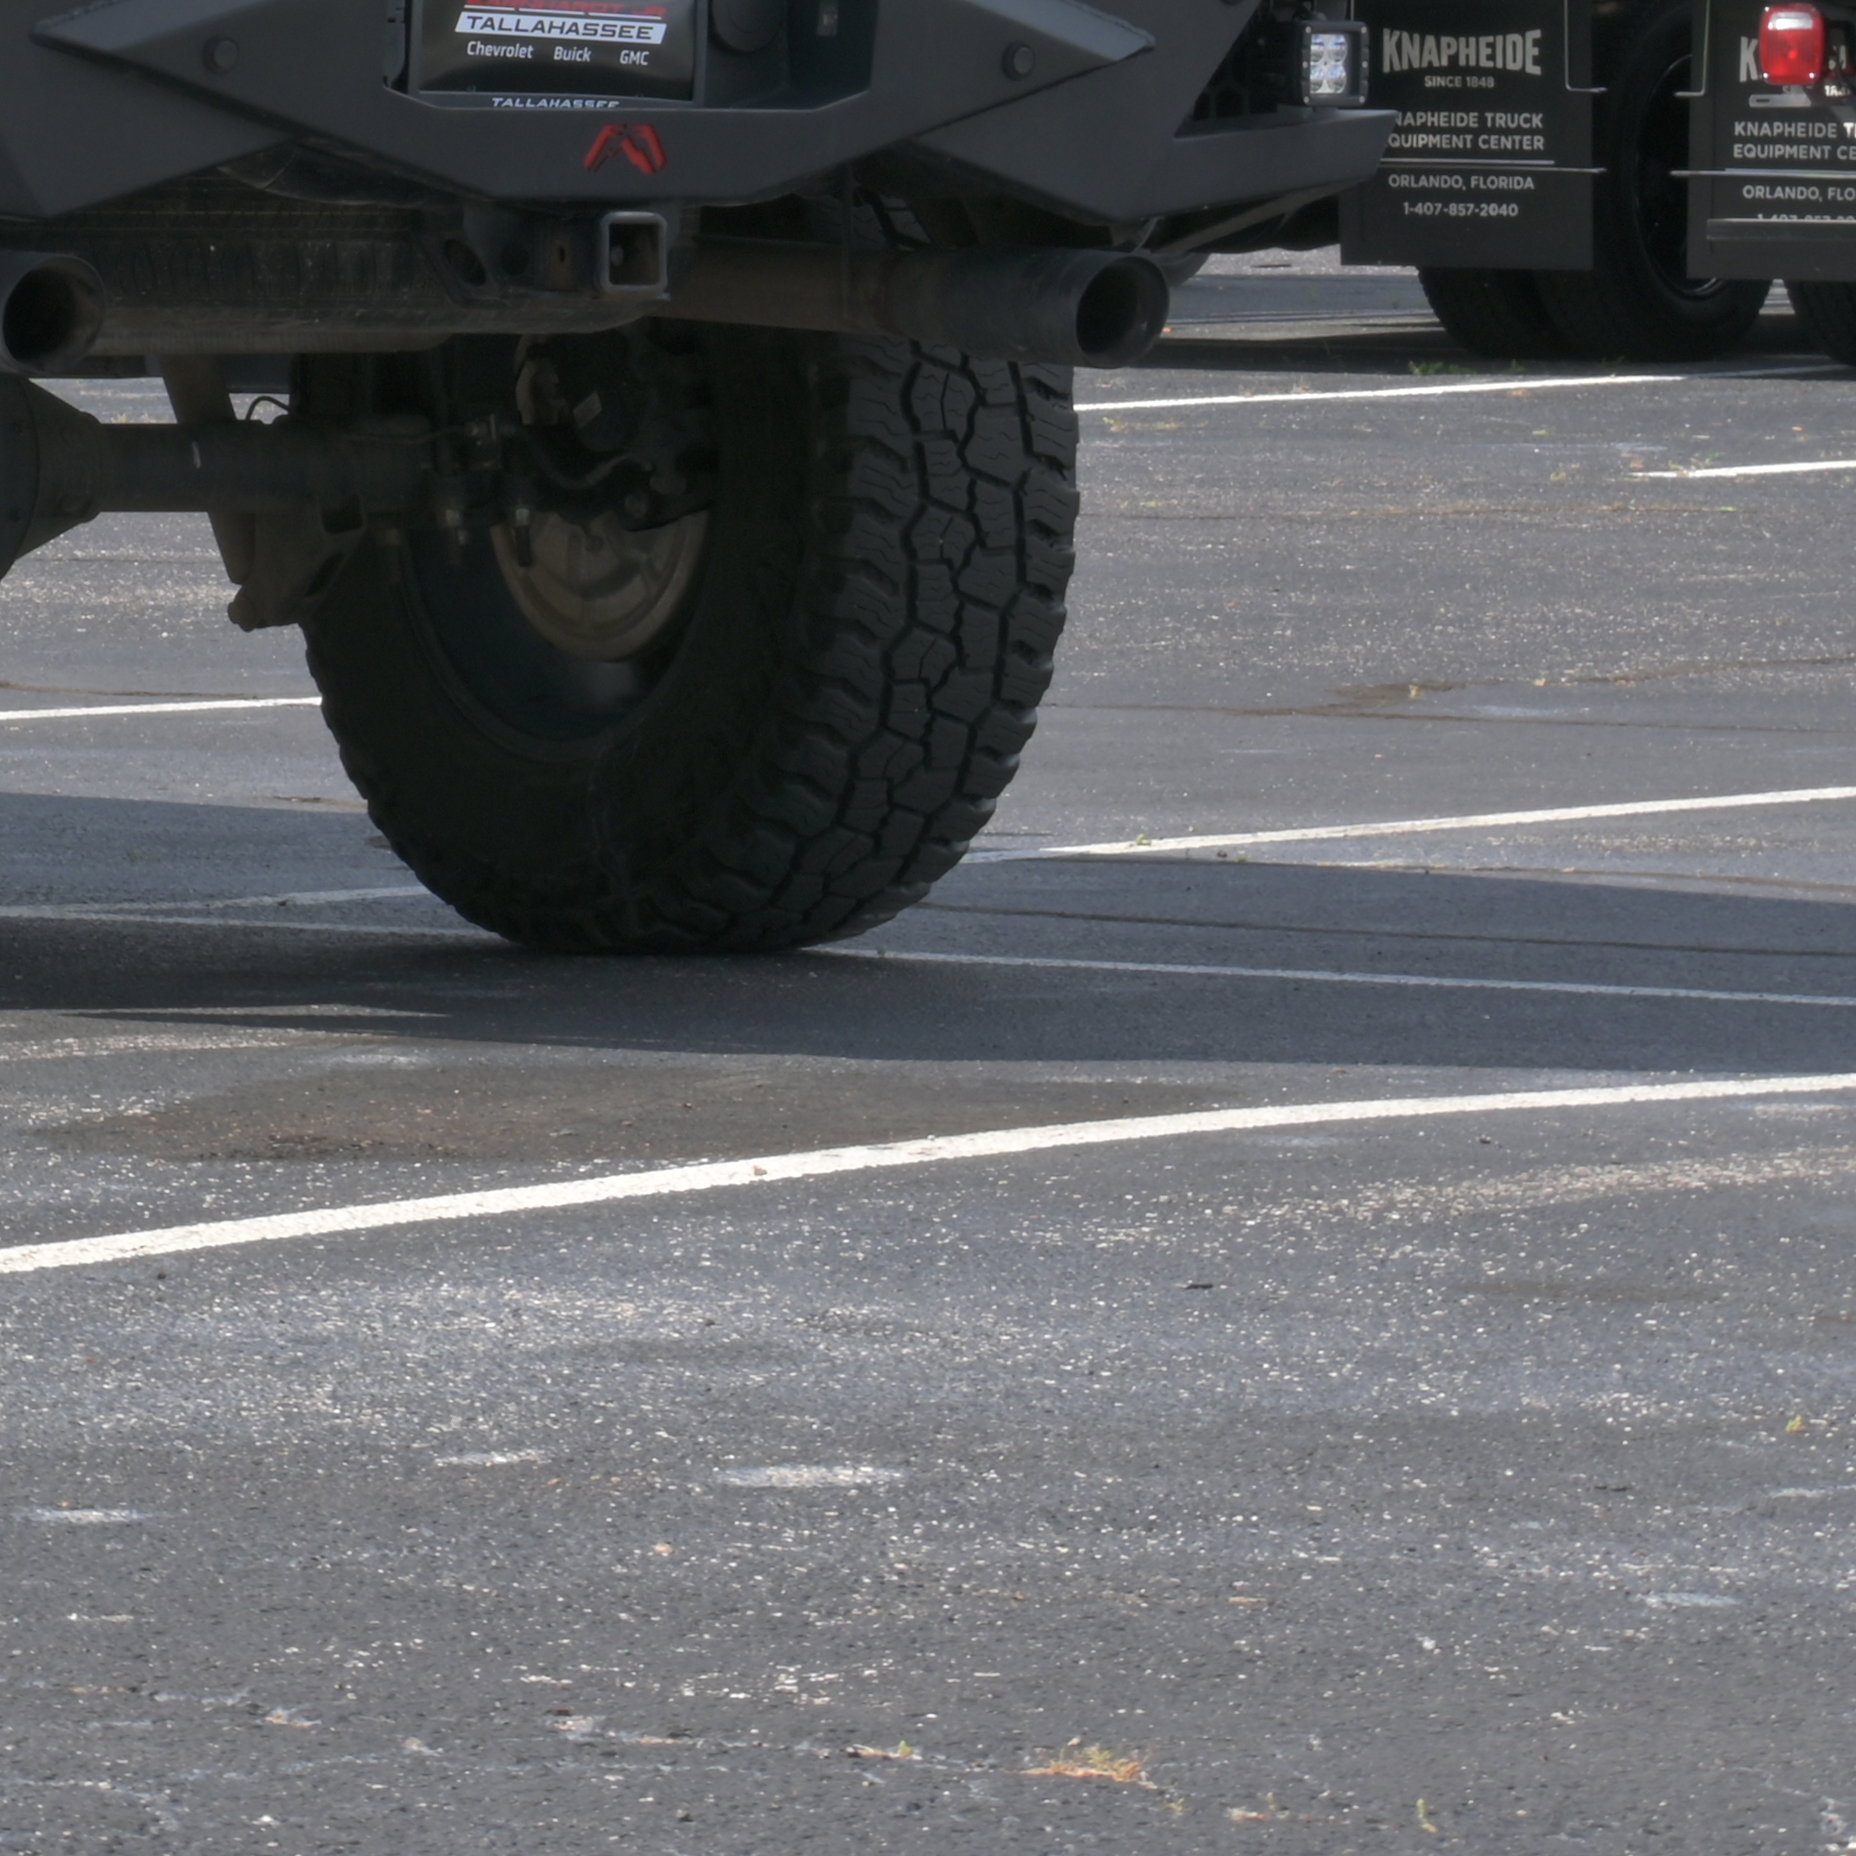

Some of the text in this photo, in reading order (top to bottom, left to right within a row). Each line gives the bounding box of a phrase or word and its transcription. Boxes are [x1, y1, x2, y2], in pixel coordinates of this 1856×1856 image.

[466, 14, 655, 41] TALLAHASSEE
[466, 40, 650, 66] Chevrolet Buick GMC
[1382, 27, 1542, 76] KNAPHEIDE
[1424, 75, 1496, 88] SINCE 1848
[1394, 110, 1544, 129] NAPHEIDE TRUCK
[1733, 121, 1838, 138] KNAPHEIDE
[1388, 133, 1545, 150] QUIPMENT CENTER
[1733, 143, 1832, 160] EQUIPMENT
[1388, 174, 1536, 191] ORLANDO, FLORIDA
[1742, 184, 1823, 202] ORLANDO,
[1403, 201, 1519, 217] 1-407-857-2040
